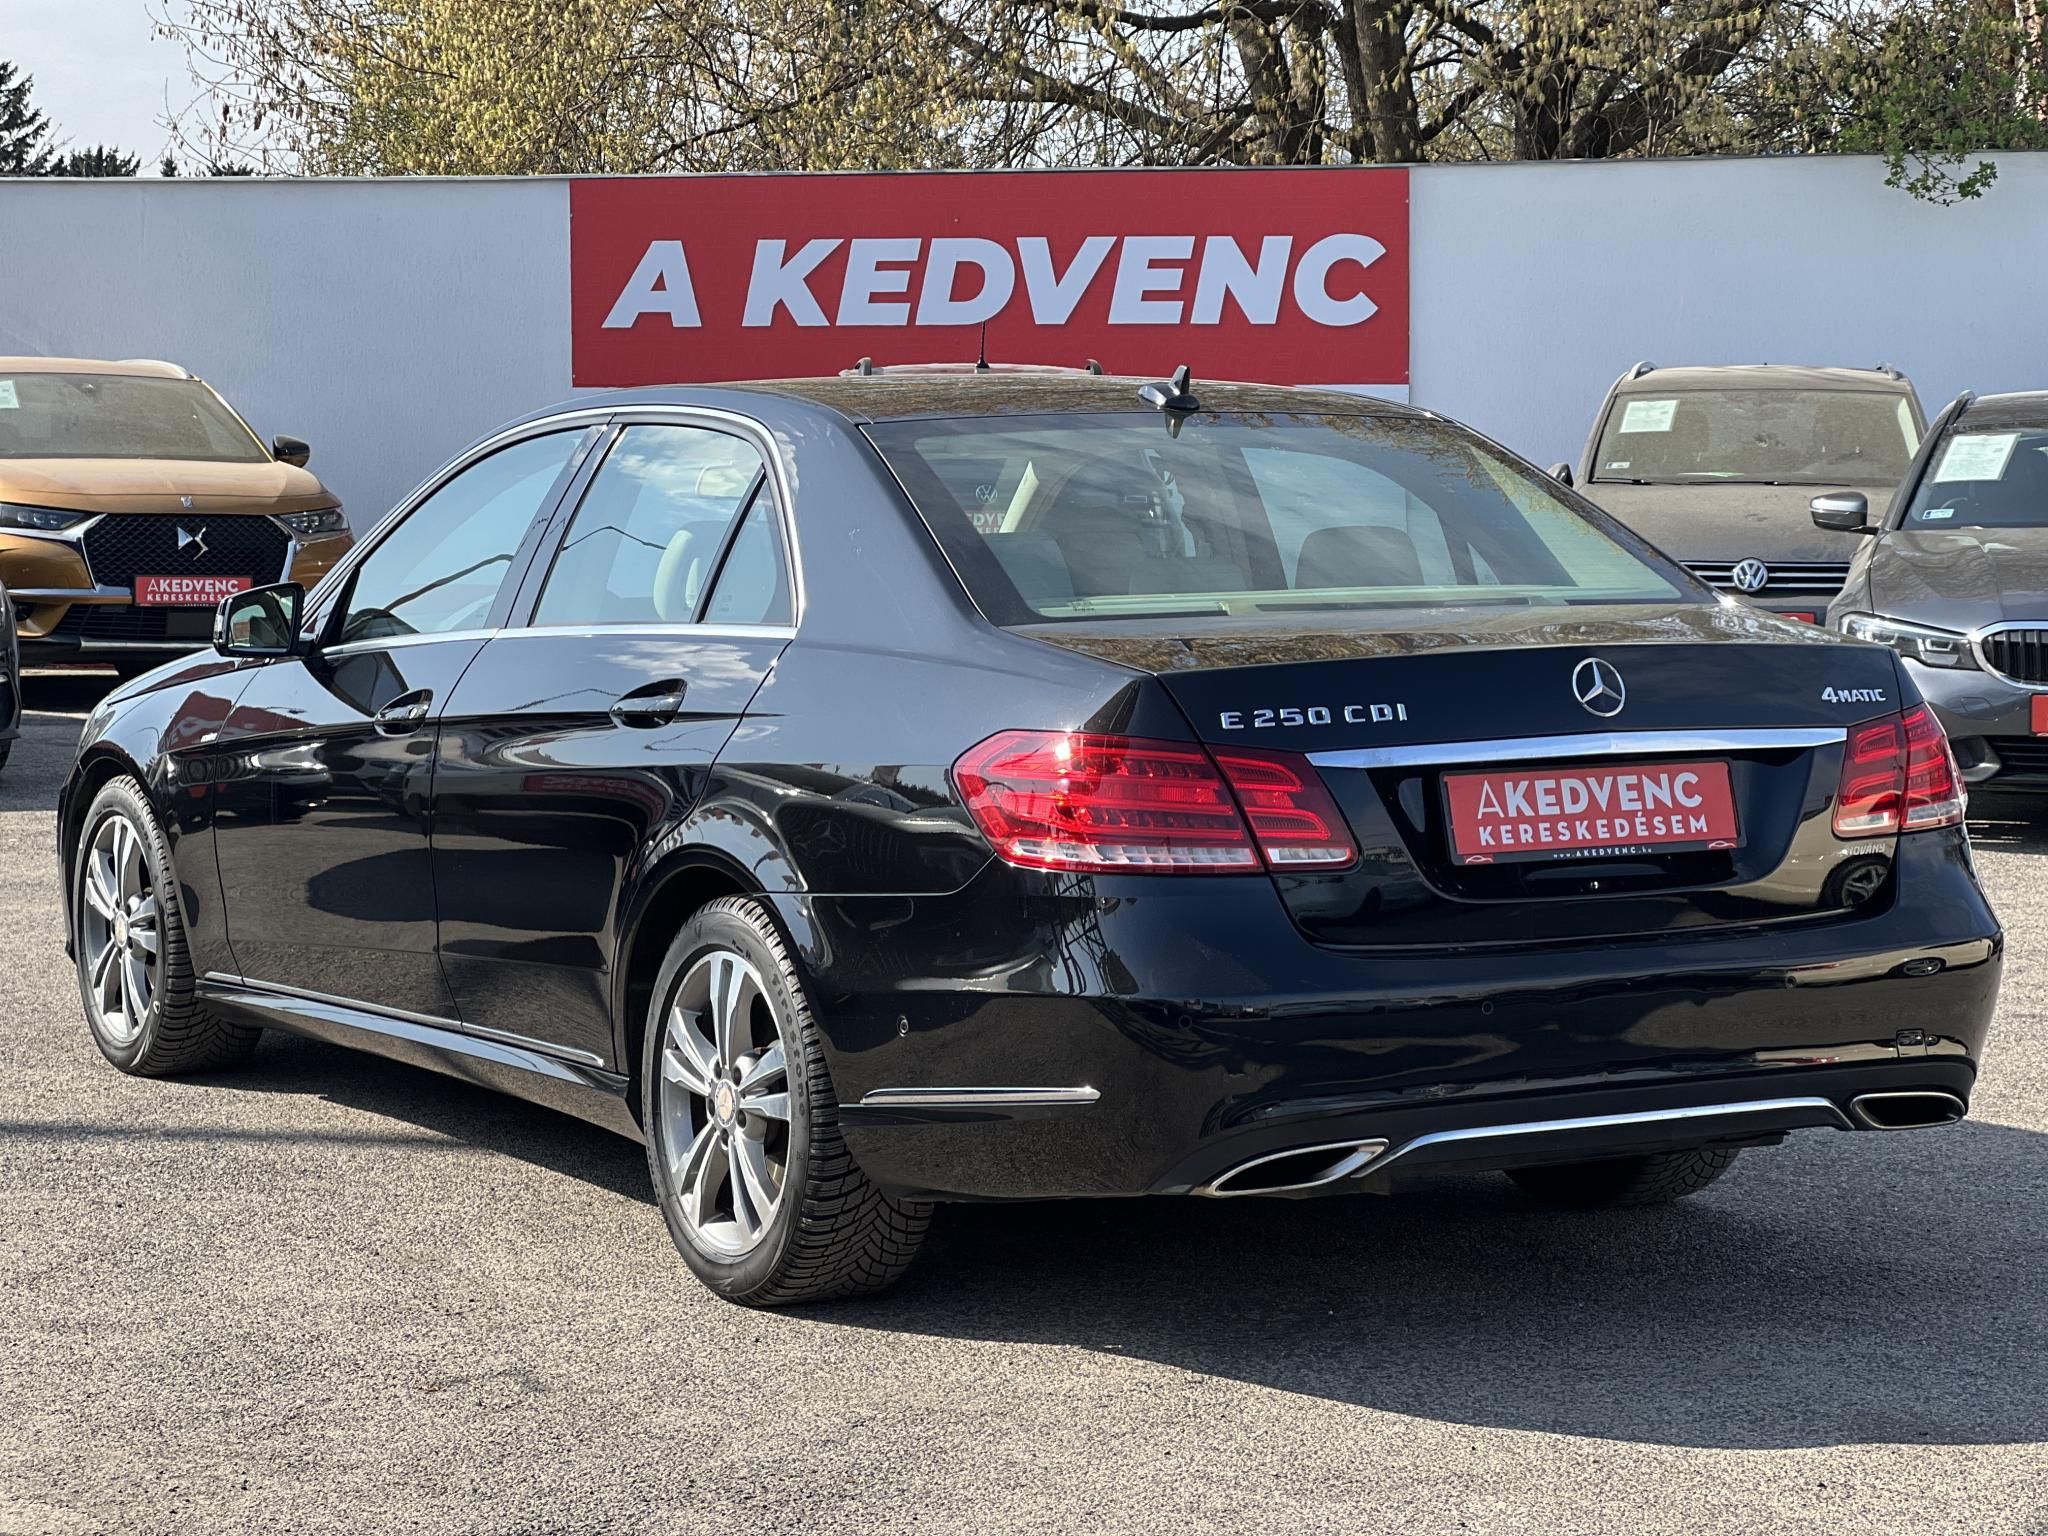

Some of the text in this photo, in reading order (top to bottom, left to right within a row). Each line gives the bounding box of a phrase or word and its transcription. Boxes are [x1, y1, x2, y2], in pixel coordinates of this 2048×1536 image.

[600, 232, 1388, 329] A KEDVENC
[147, 578, 239, 593] AKEDVENC
[1821, 686, 1887, 703] 4MATIC
[1219, 703, 1408, 729] E 250 CDI
[1477, 771, 1703, 820] AKEDVENC
[1478, 811, 1709, 847] KERESKEDÉSEM
